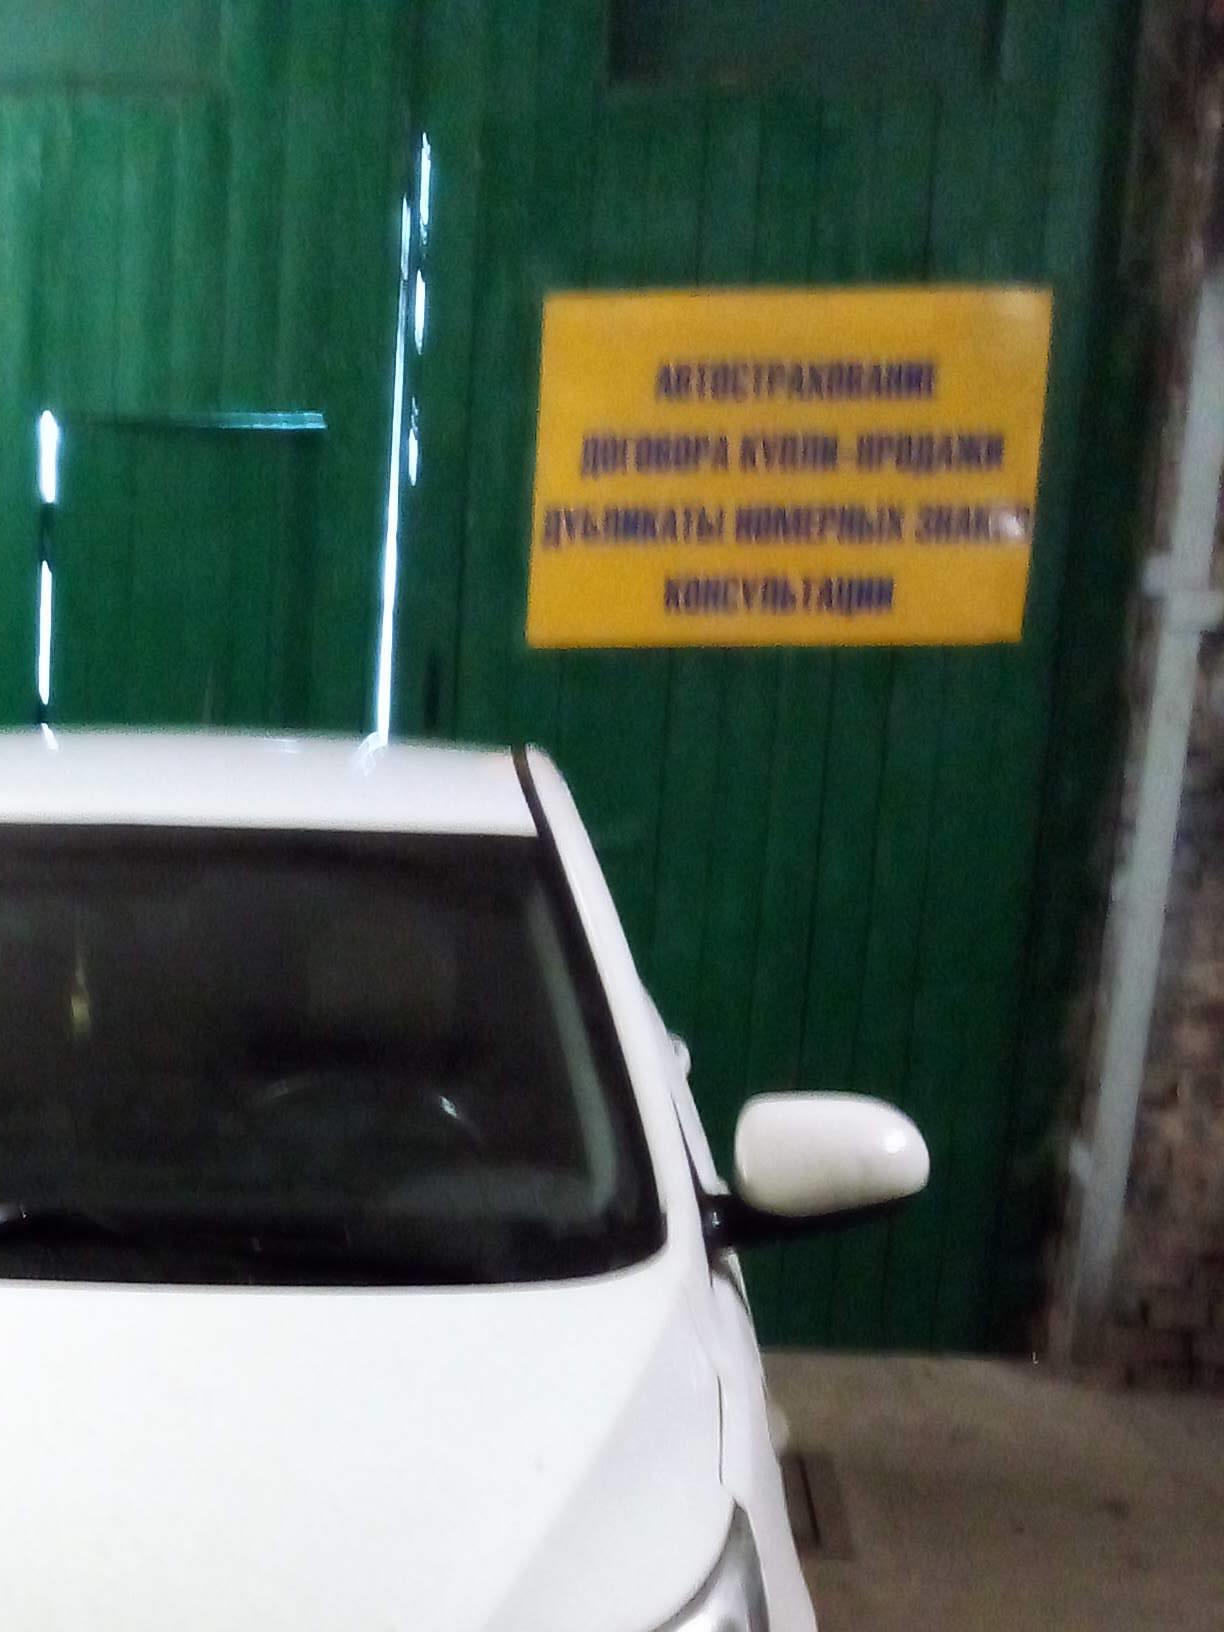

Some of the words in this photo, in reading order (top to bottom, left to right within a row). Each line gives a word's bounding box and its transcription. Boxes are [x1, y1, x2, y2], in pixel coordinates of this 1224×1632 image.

[656, 359, 937, 401] АВТОСТРАХОВАНИЕ
[581, 432, 729, 477] ДОГОВОРА
[542, 505, 725, 552] ДУБЛИКАТЫ
[734, 505, 904, 545] НОМЕРНЫХ
